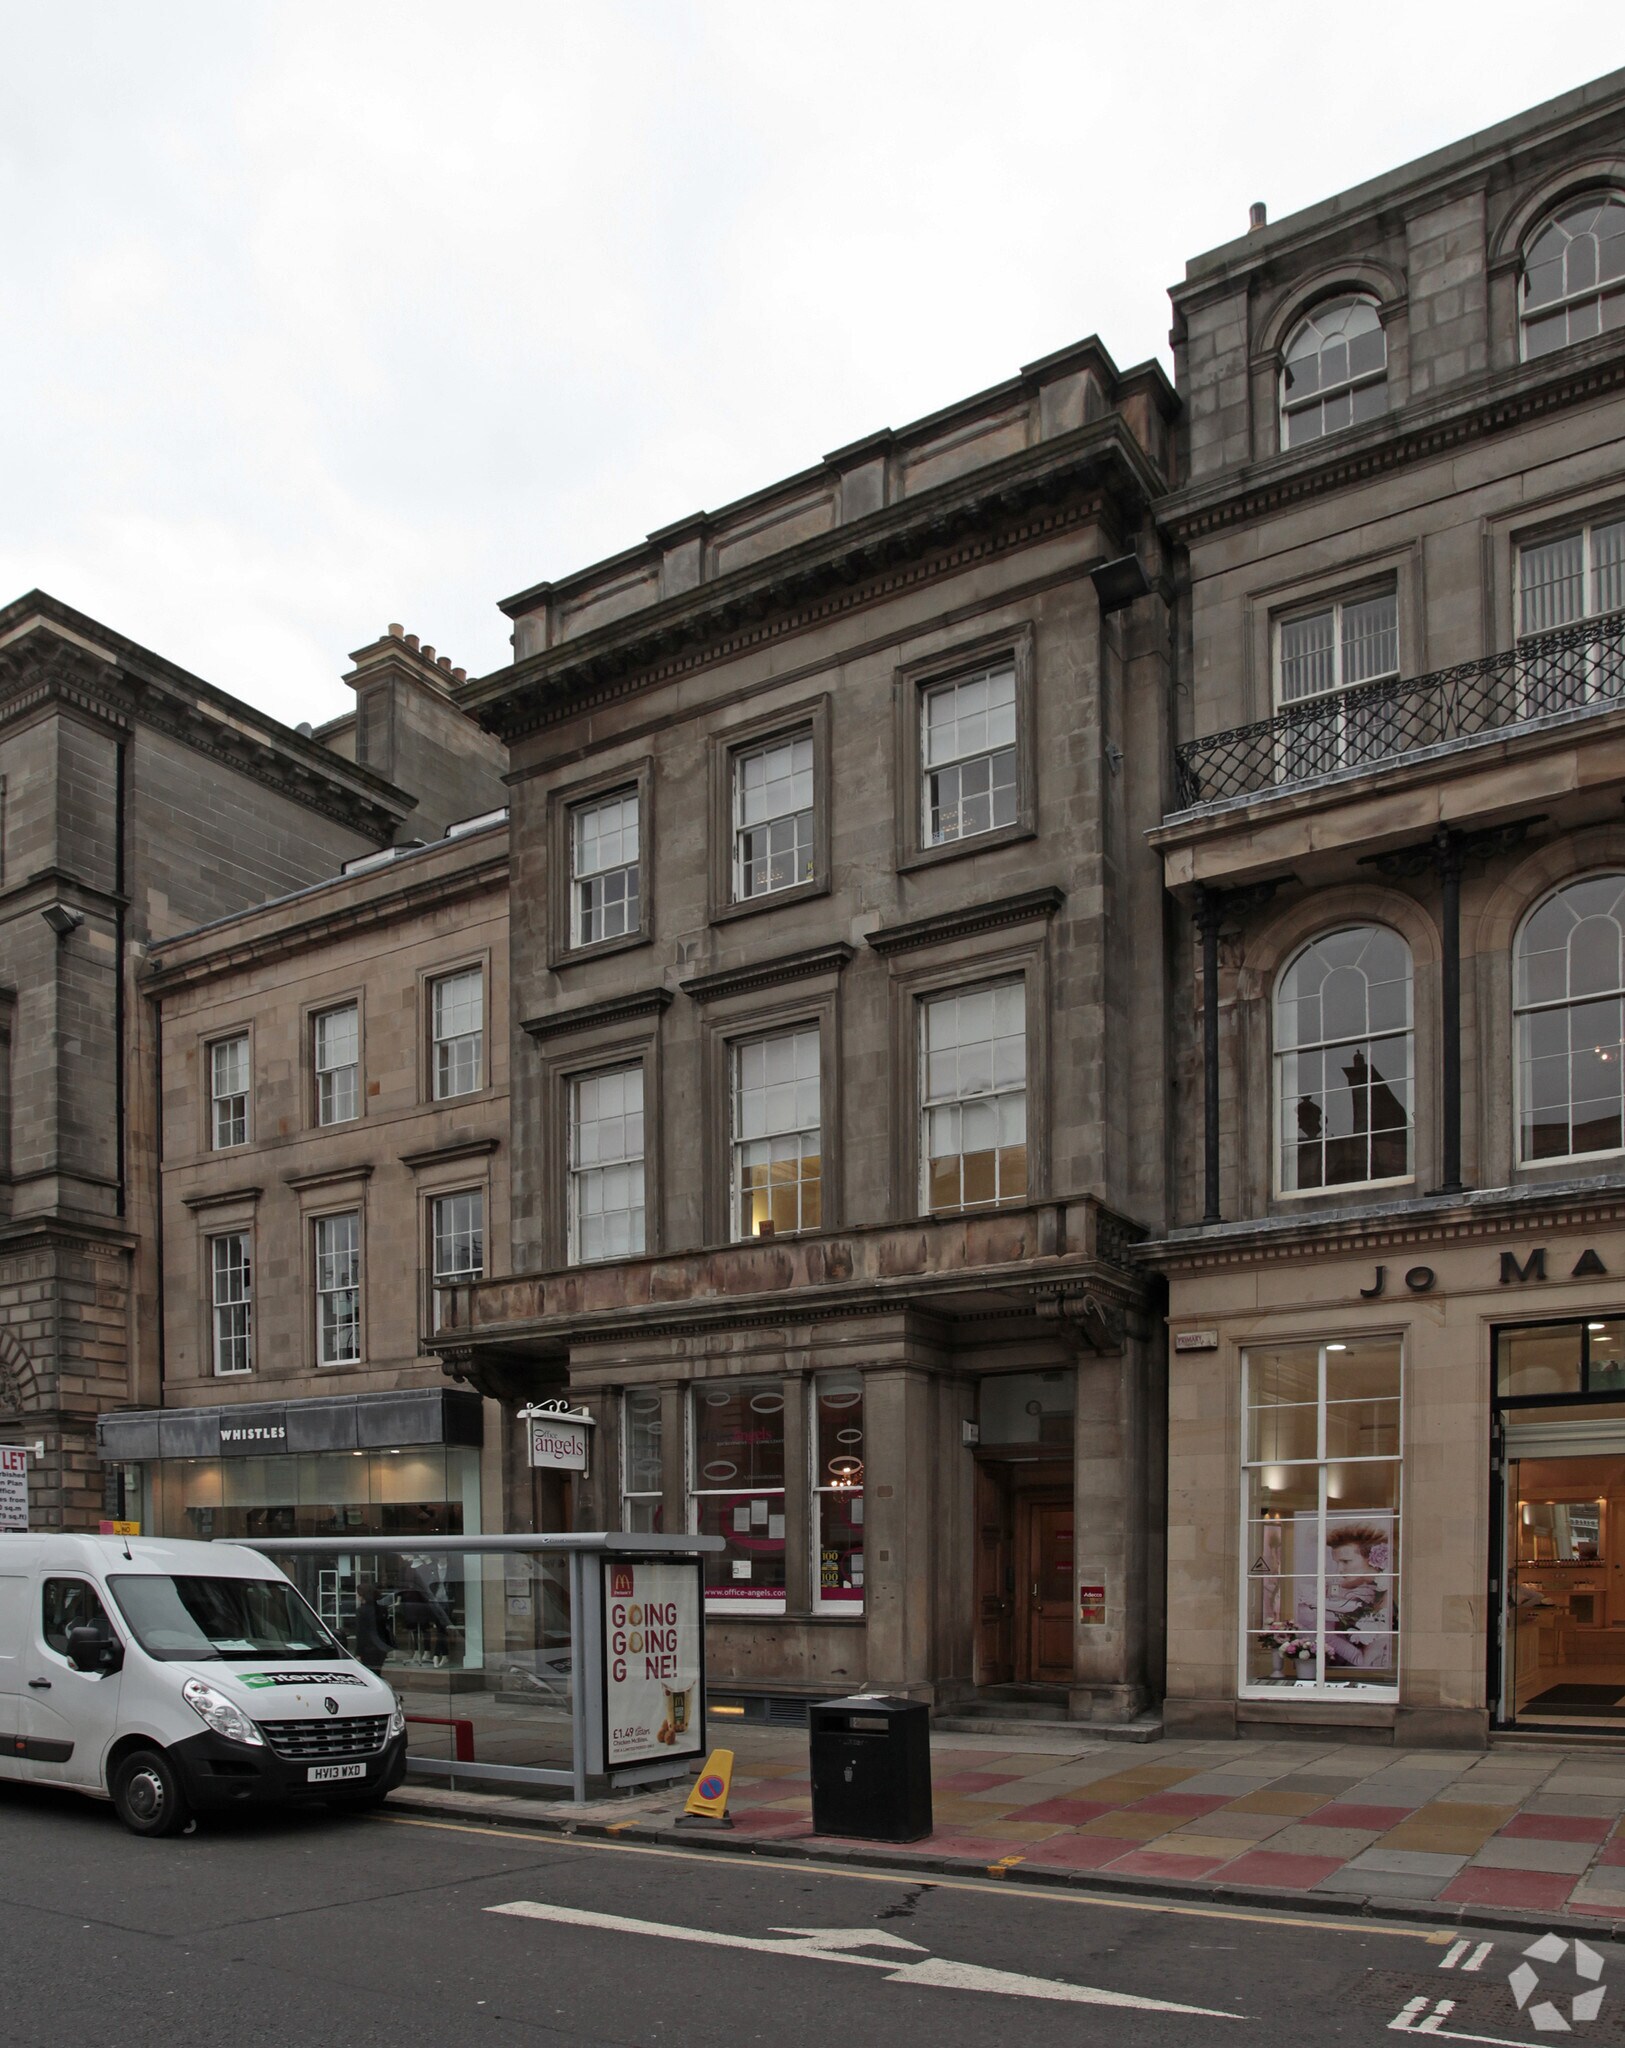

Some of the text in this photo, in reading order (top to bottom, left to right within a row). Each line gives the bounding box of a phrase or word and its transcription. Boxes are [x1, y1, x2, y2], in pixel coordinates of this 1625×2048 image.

[1499, 1247, 1608, 1284] MA
[220, 1426, 286, 1441] WHISTLES
[535, 1435, 584, 1460] angels
[2, 1451, 25, 1470] LET
[822, 1552, 838, 1561] 100
[611, 1602, 677, 1629] GOING
[612, 1629, 678, 1655] GOING
[245, 1673, 361, 1684] enterprise
[613, 1727, 634, 1739] £1.49
[315, 1765, 360, 1780] HV13 WXD
